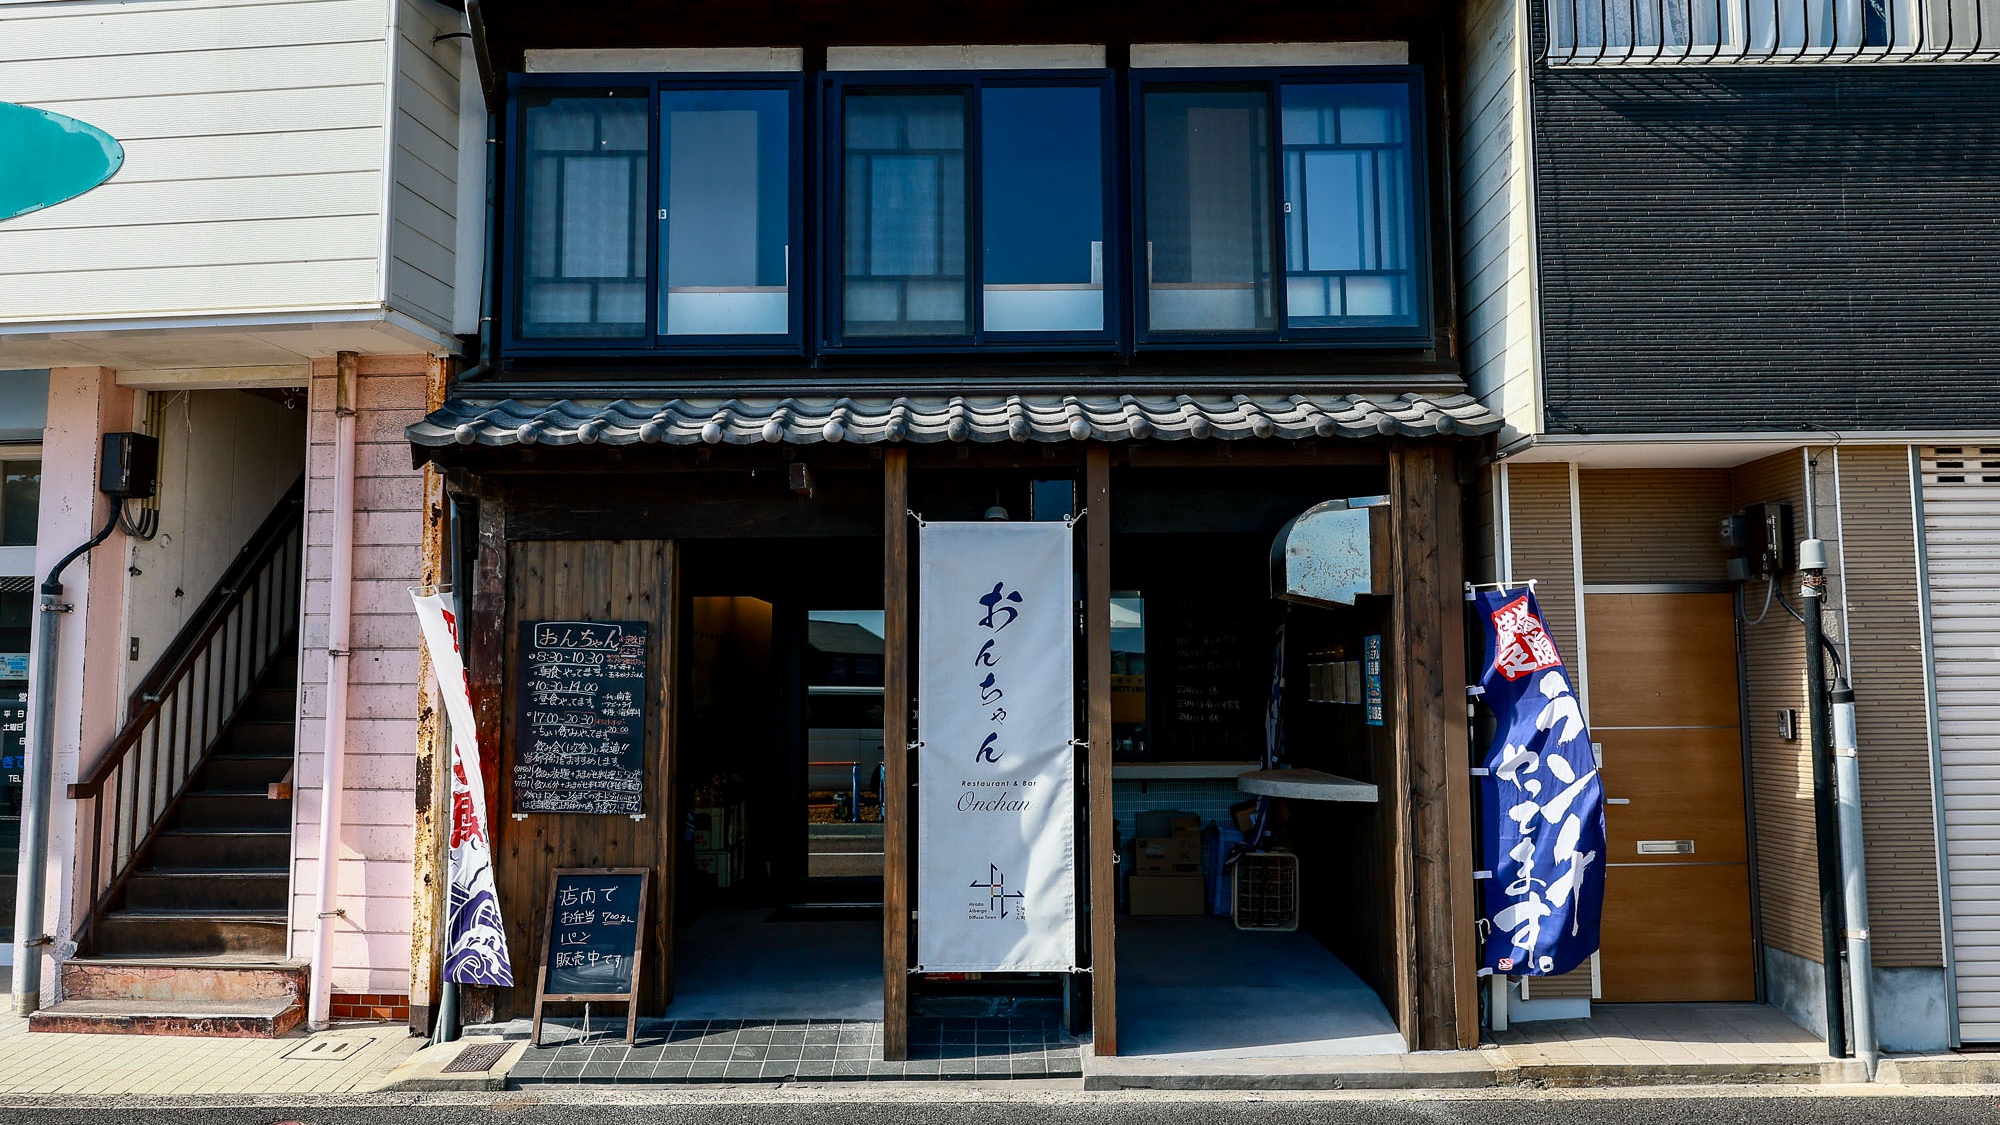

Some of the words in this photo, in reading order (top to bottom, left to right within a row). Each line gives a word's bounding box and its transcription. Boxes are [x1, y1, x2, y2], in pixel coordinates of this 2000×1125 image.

[538, 628, 620, 648] おんちゃん
[975, 581, 1024, 764] おんちゃん
[3, 723, 24, 731] 土曜日
[8, 774, 22, 782] TEL
[957, 790, 1034, 812] Onchan
[1535, 670, 1597, 937] ランチ
[560, 885, 619, 906] 店内で
[561, 909, 596, 924] お弁当
[560, 931, 592, 944] パン
[556, 949, 622, 969] 販売中です
